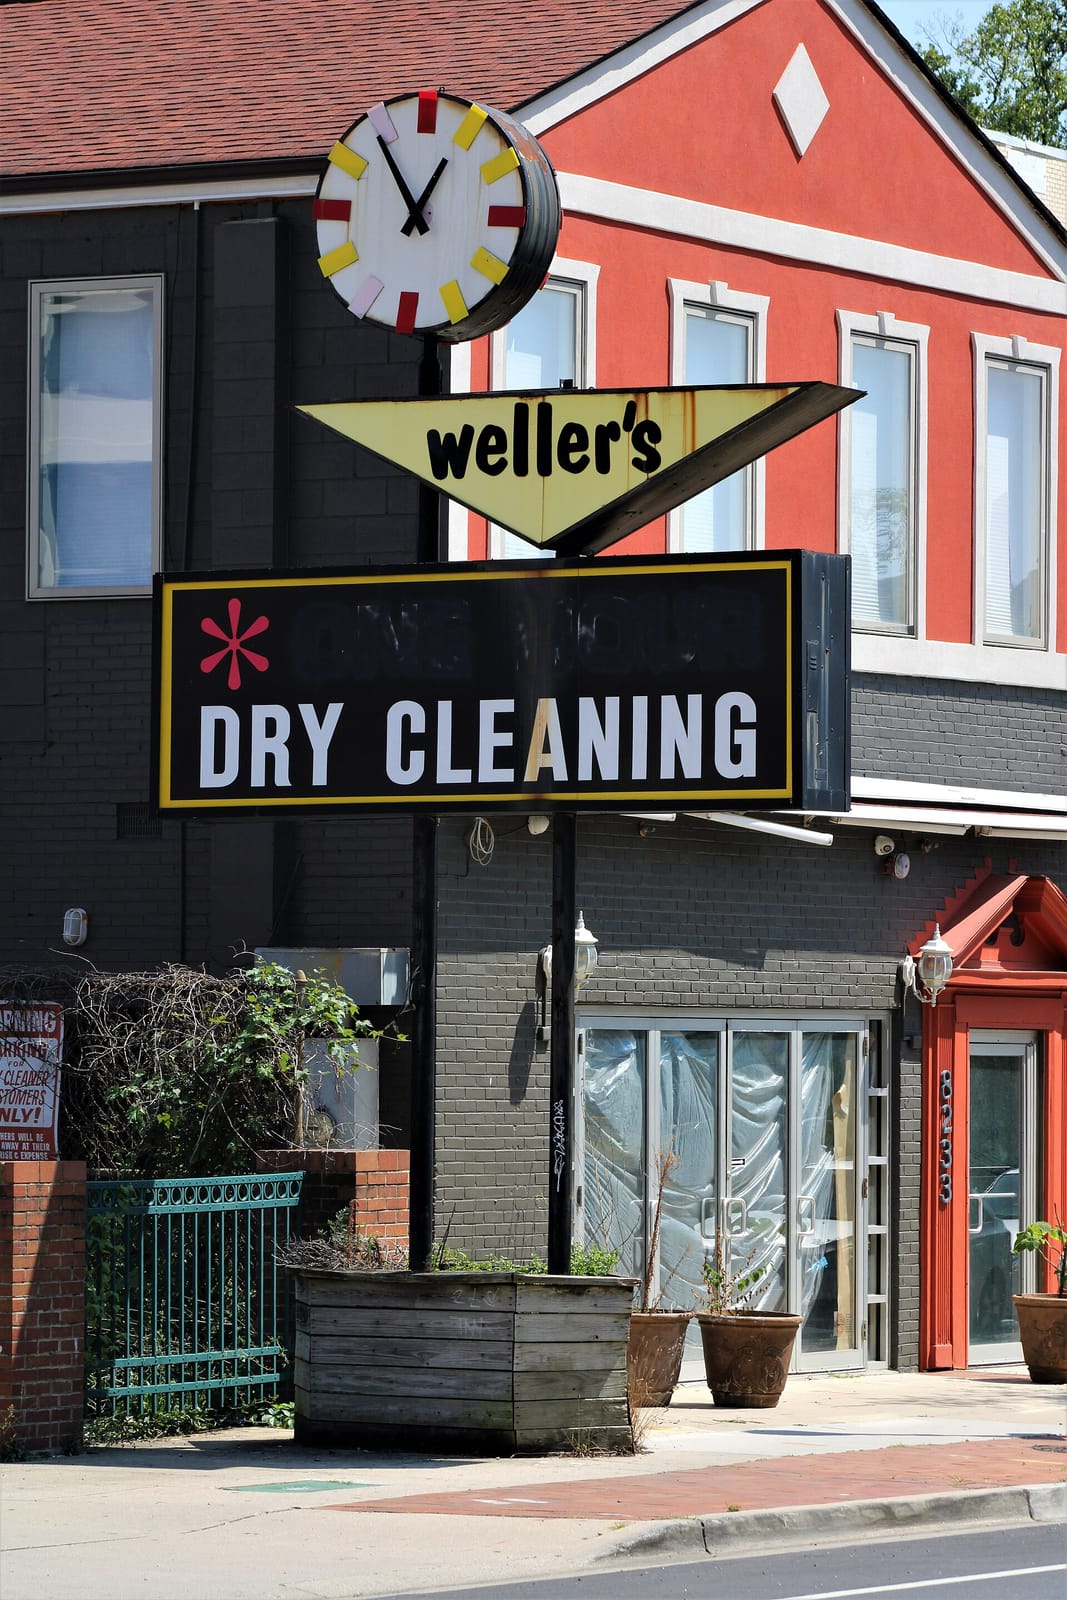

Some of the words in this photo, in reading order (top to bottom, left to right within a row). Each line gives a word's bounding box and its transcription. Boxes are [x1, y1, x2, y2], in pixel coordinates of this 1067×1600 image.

[426, 400, 662, 480] weller's
[200, 702, 344, 788] DRY
[386, 691, 757, 785] CLEANING
[1, 1142, 19, 1150] AWAY
[22, 1142, 30, 1151] AT
[32, 1143, 50, 1151] THEIR
[18, 1133, 33, 1141] WILL
[36, 1133, 44, 1142] BE
[21, 1151, 48, 1160] EXPENSE
[939, 1069, 953, 1204] 8233
